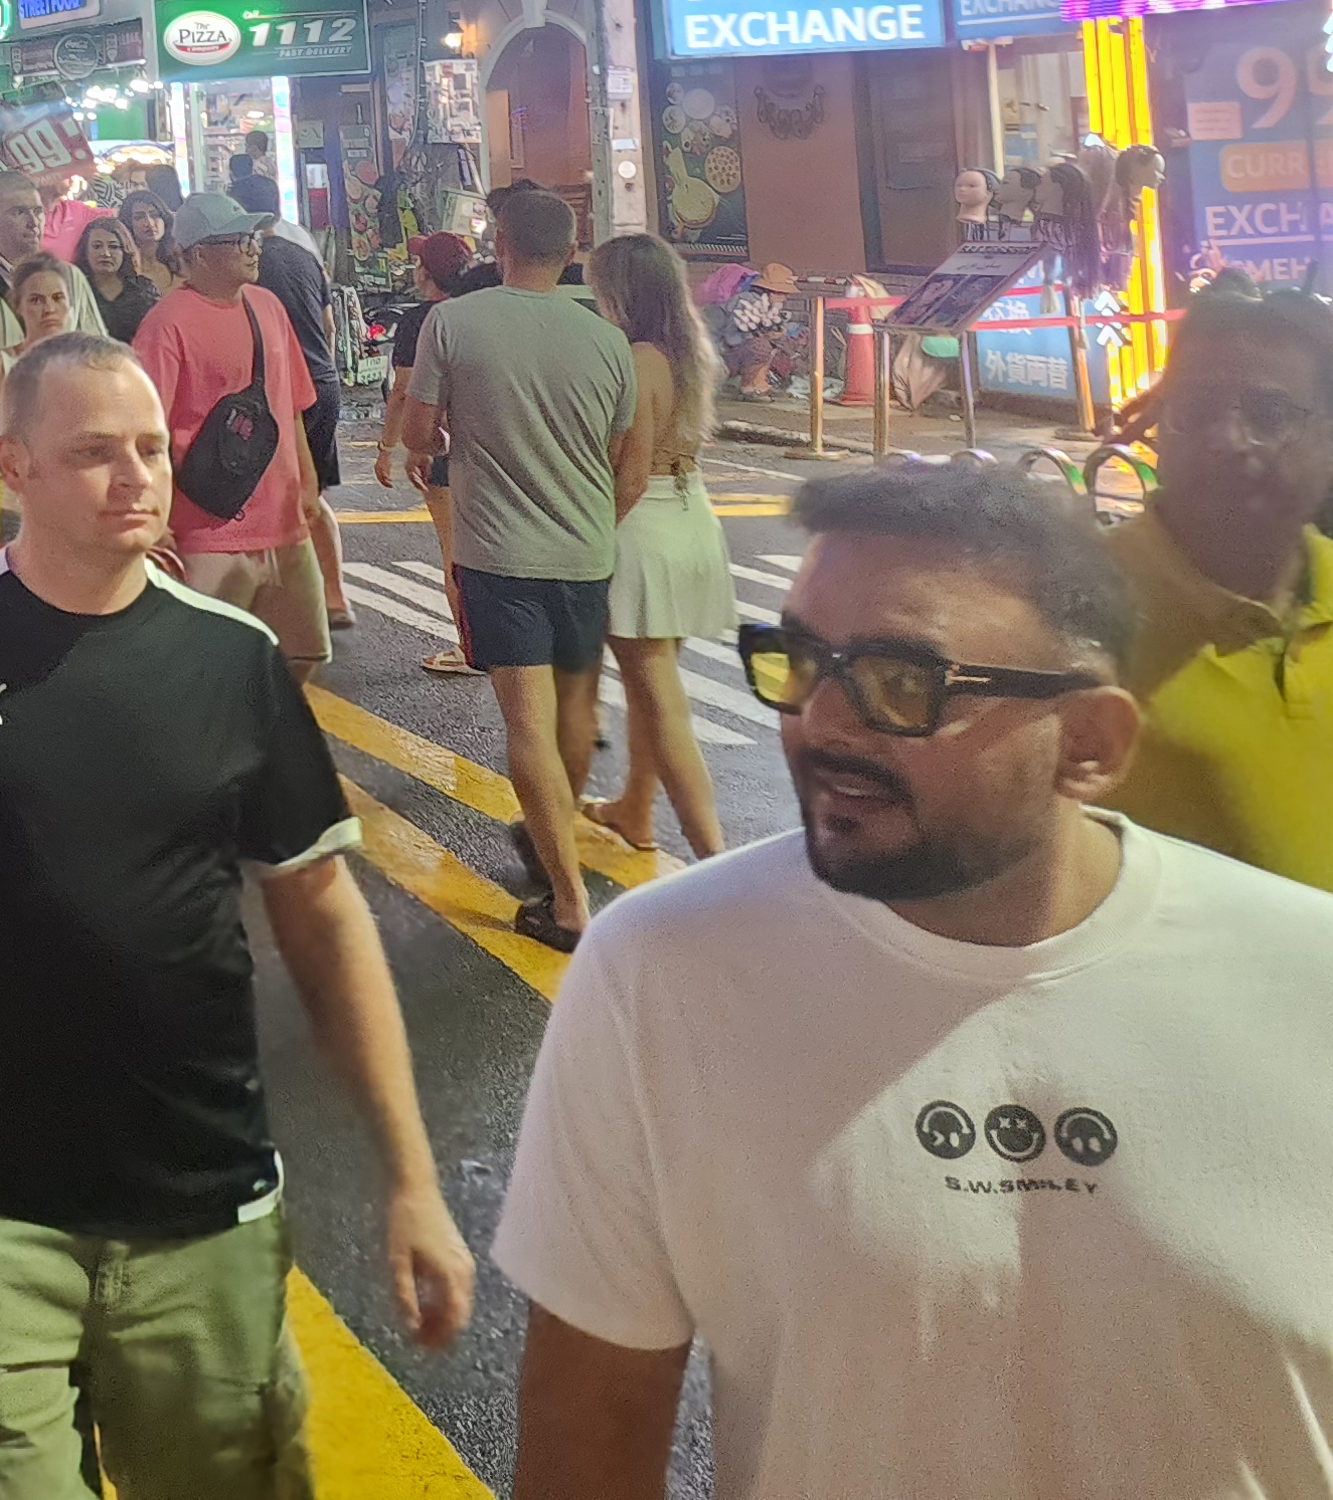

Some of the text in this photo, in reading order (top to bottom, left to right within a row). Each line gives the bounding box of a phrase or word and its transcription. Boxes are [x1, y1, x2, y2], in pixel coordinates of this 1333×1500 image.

[178, 29, 227, 43] PIZZA
[249, 18, 357, 47] 1112
[684, 3, 926, 49] EXCHANGE
[944, 1174, 1099, 1195] S.W.SMILEY
